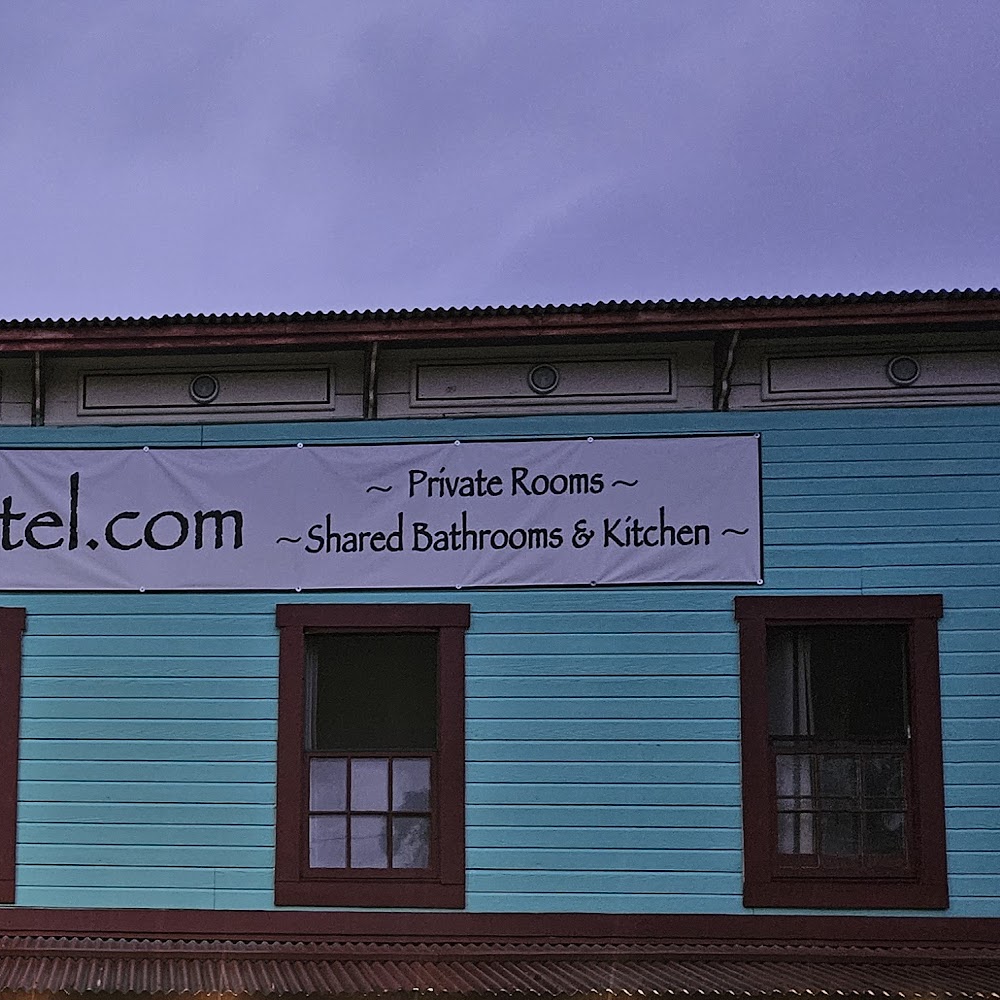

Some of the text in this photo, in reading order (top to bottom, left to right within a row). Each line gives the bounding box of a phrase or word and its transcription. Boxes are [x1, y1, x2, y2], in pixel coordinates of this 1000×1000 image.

[409, 467, 503, 498] Private
[511, 467, 605, 497] Rooms
[412, 511, 563, 552] Bathrooms
[571, 519, 595, 548] &
[603, 506, 710, 548] Kitchen
